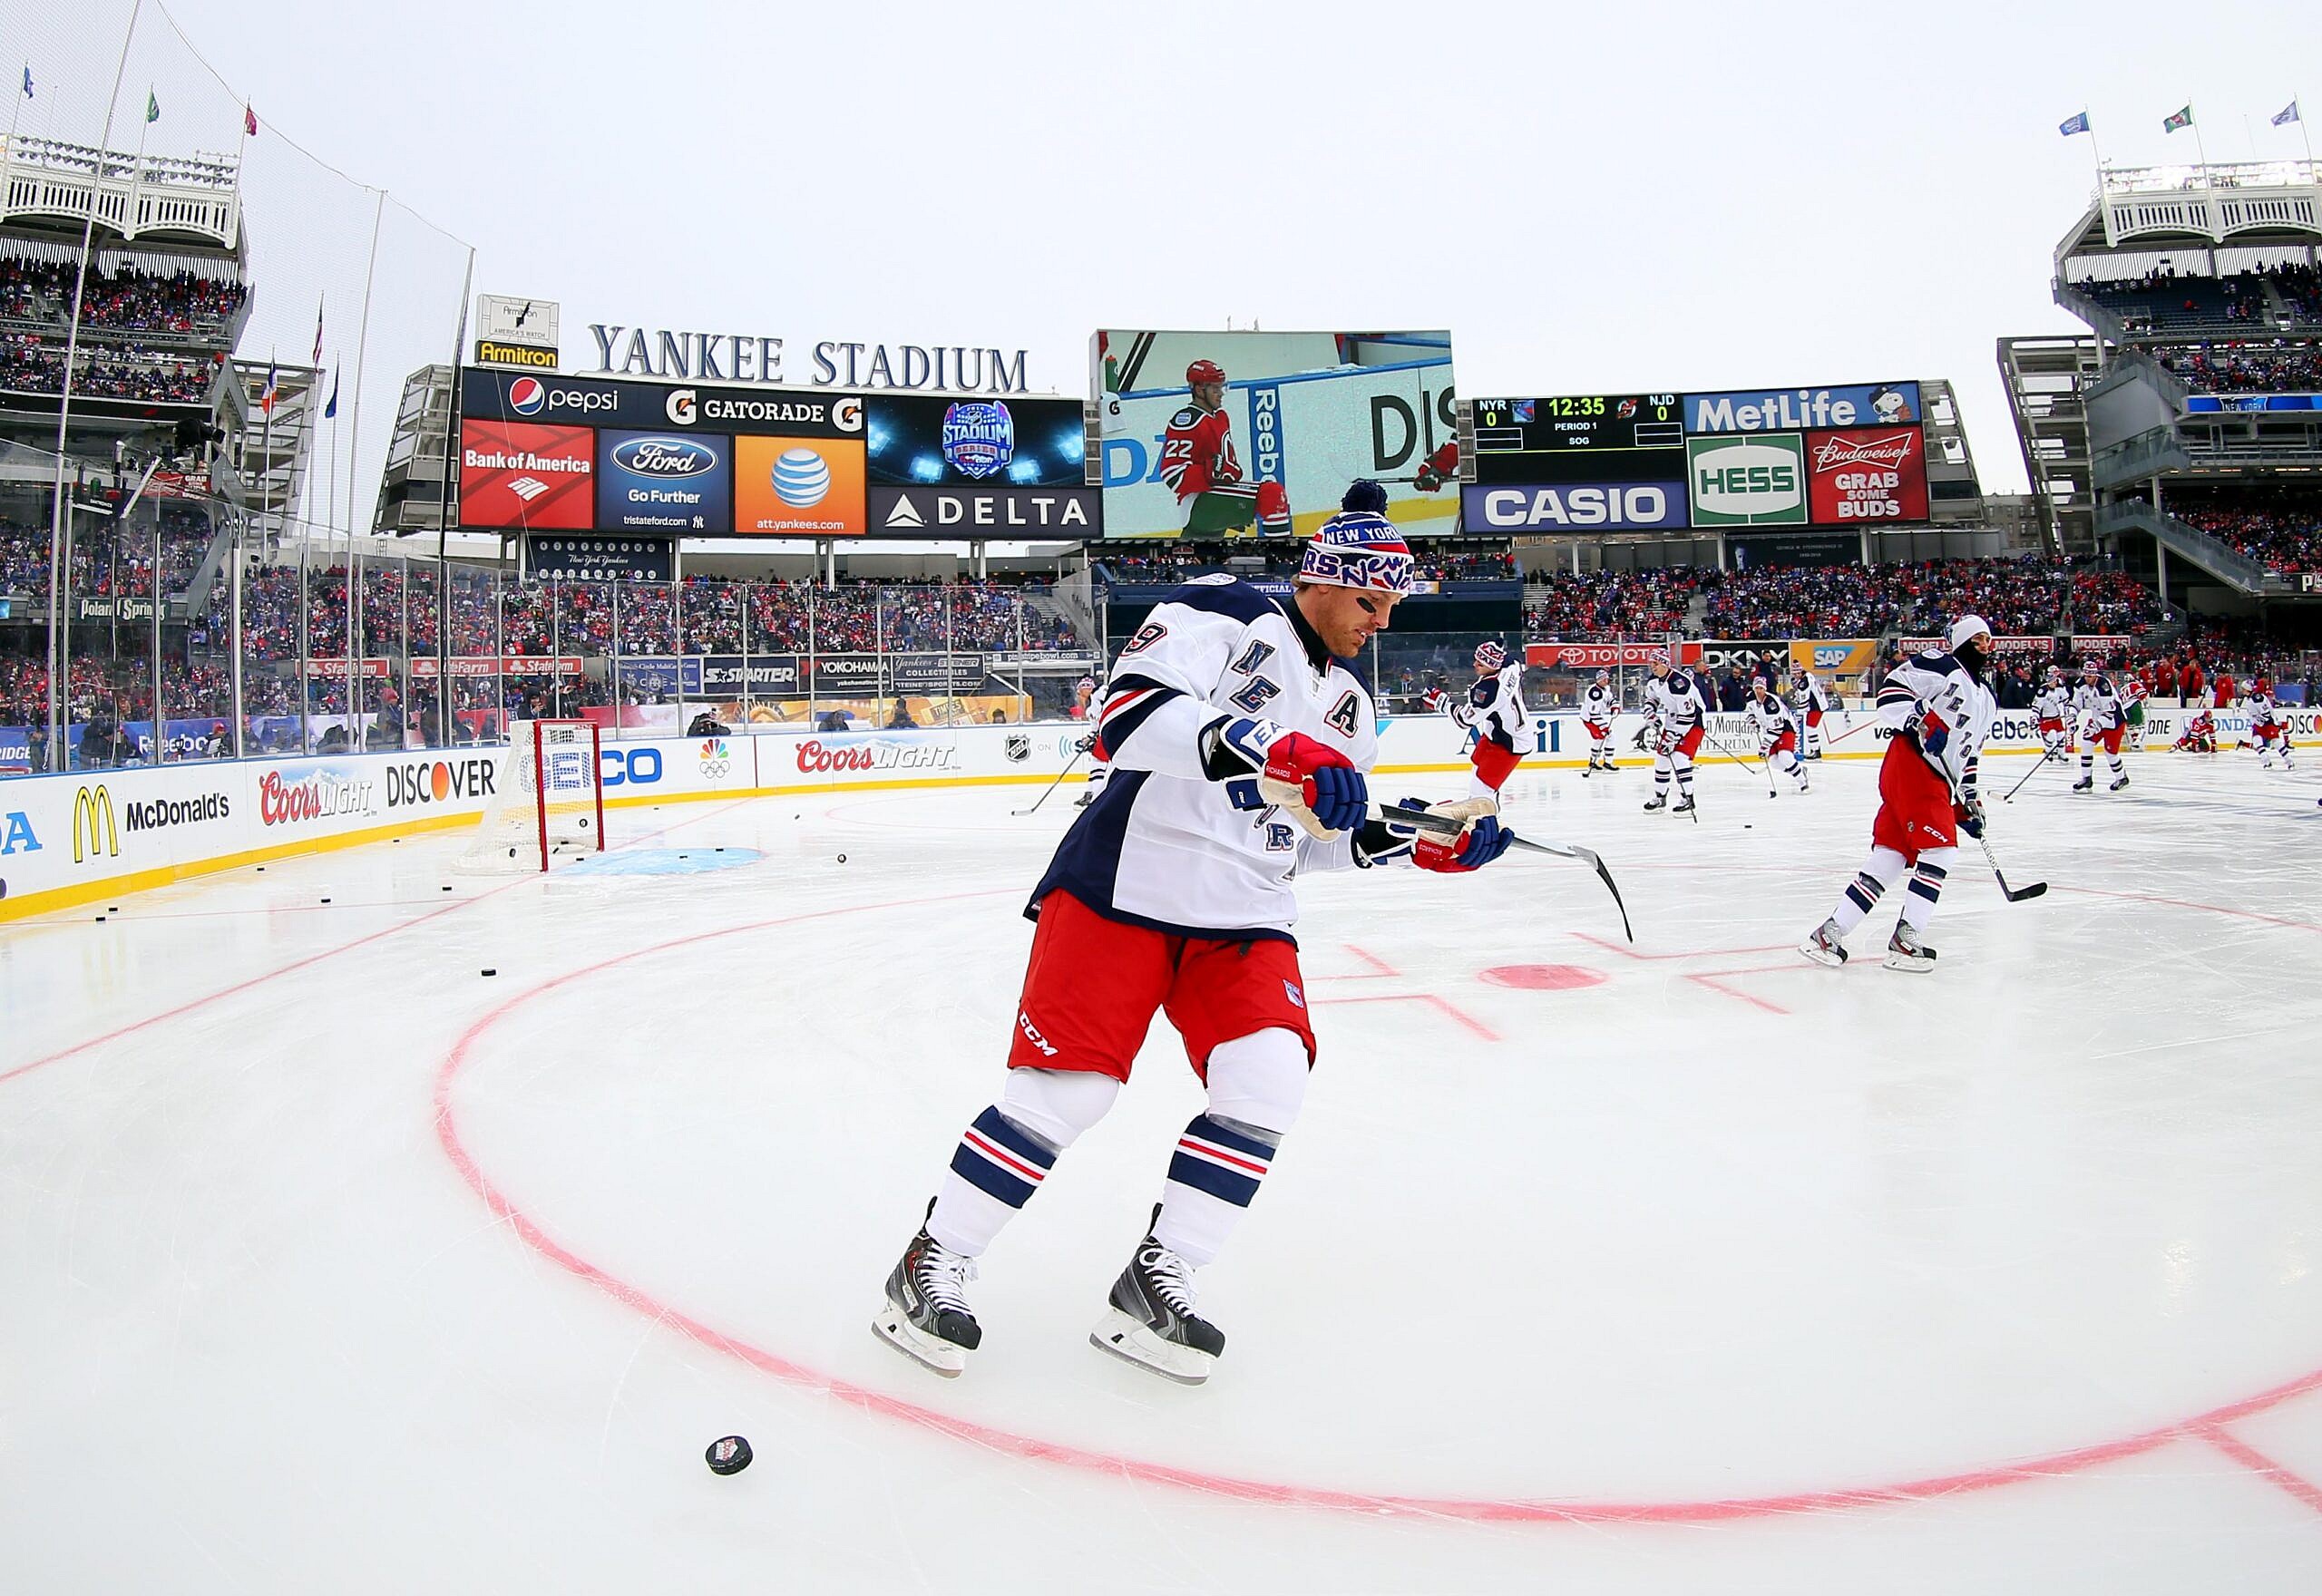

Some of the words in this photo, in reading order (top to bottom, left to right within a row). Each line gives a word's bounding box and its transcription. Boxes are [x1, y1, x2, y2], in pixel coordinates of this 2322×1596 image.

[481, 342, 557, 367] Armitron
[589, 324, 784, 383] YANKEE
[812, 341, 1029, 393] STADIUM
[548, 389, 619, 414] pepsi
[1479, 399, 1507, 411] NYR
[1548, 397, 1605, 416] 12:35
[1649, 394, 1675, 406] NJD
[705, 400, 824, 423] GATORADE
[1486, 412, 1497, 427] 0
[1657, 405, 1668, 422] 0
[1697, 389, 1857, 433] MetLife
[943, 423, 1011, 445] STADIUM
[1555, 423, 1590, 432] PERIOD
[1592, 422, 1597, 431] 1
[1166, 439, 1194, 459] 22
[1568, 437, 1590, 445] SOG
[465, 449, 508, 470] Bank
[508, 452, 524, 470] of
[525, 453, 590, 473] America
[632, 443, 696, 472] Ford
[1813, 441, 1912, 464] Budweiser
[1700, 466, 1795, 495] HESS
[1835, 472, 1899, 491] GRAB
[629, 490, 649, 502] Go
[650, 490, 701, 504] Further
[1847, 490, 1889, 500] SOME
[938, 496, 1088, 526] DELTA
[1485, 486, 1667, 527] CASIO
[1838, 500, 1901, 518] BUDS
[623, 515, 687, 528] tristateford.com
[756, 519, 844, 531] att.yankees.com
[1326, 528, 1360, 544] NEW
[568, 554, 584, 564] New
[584, 554, 601, 567] York
[601, 555, 629, 567] Yankees
[1252, 585, 1292, 593] FICIAL
[81, 598, 121, 620] Polan
[1588, 648, 1651, 662] TOYOT
[1814, 650, 1846, 667] SAP
[821, 661, 889, 674] YOKOHAMA
[1324, 689, 1361, 739] A
[139, 734, 208, 754] Reebo
[1038, 744, 1051, 752] ON
[1724, 738, 1751, 749] RUM
[795, 740, 874, 774] Coors
[873, 745, 955, 769] LIGHT
[520, 747, 663, 793] GEICO
[386, 759, 497, 807] DISCOVER
[259, 770, 322, 826] Coors
[320, 780, 373, 816] LIGHT
[126, 793, 229, 832] McDonald's
[0, 811, 44, 855] A
[1923, 824, 1949, 843] CCM
[1018, 1010, 1059, 1057] CCM
